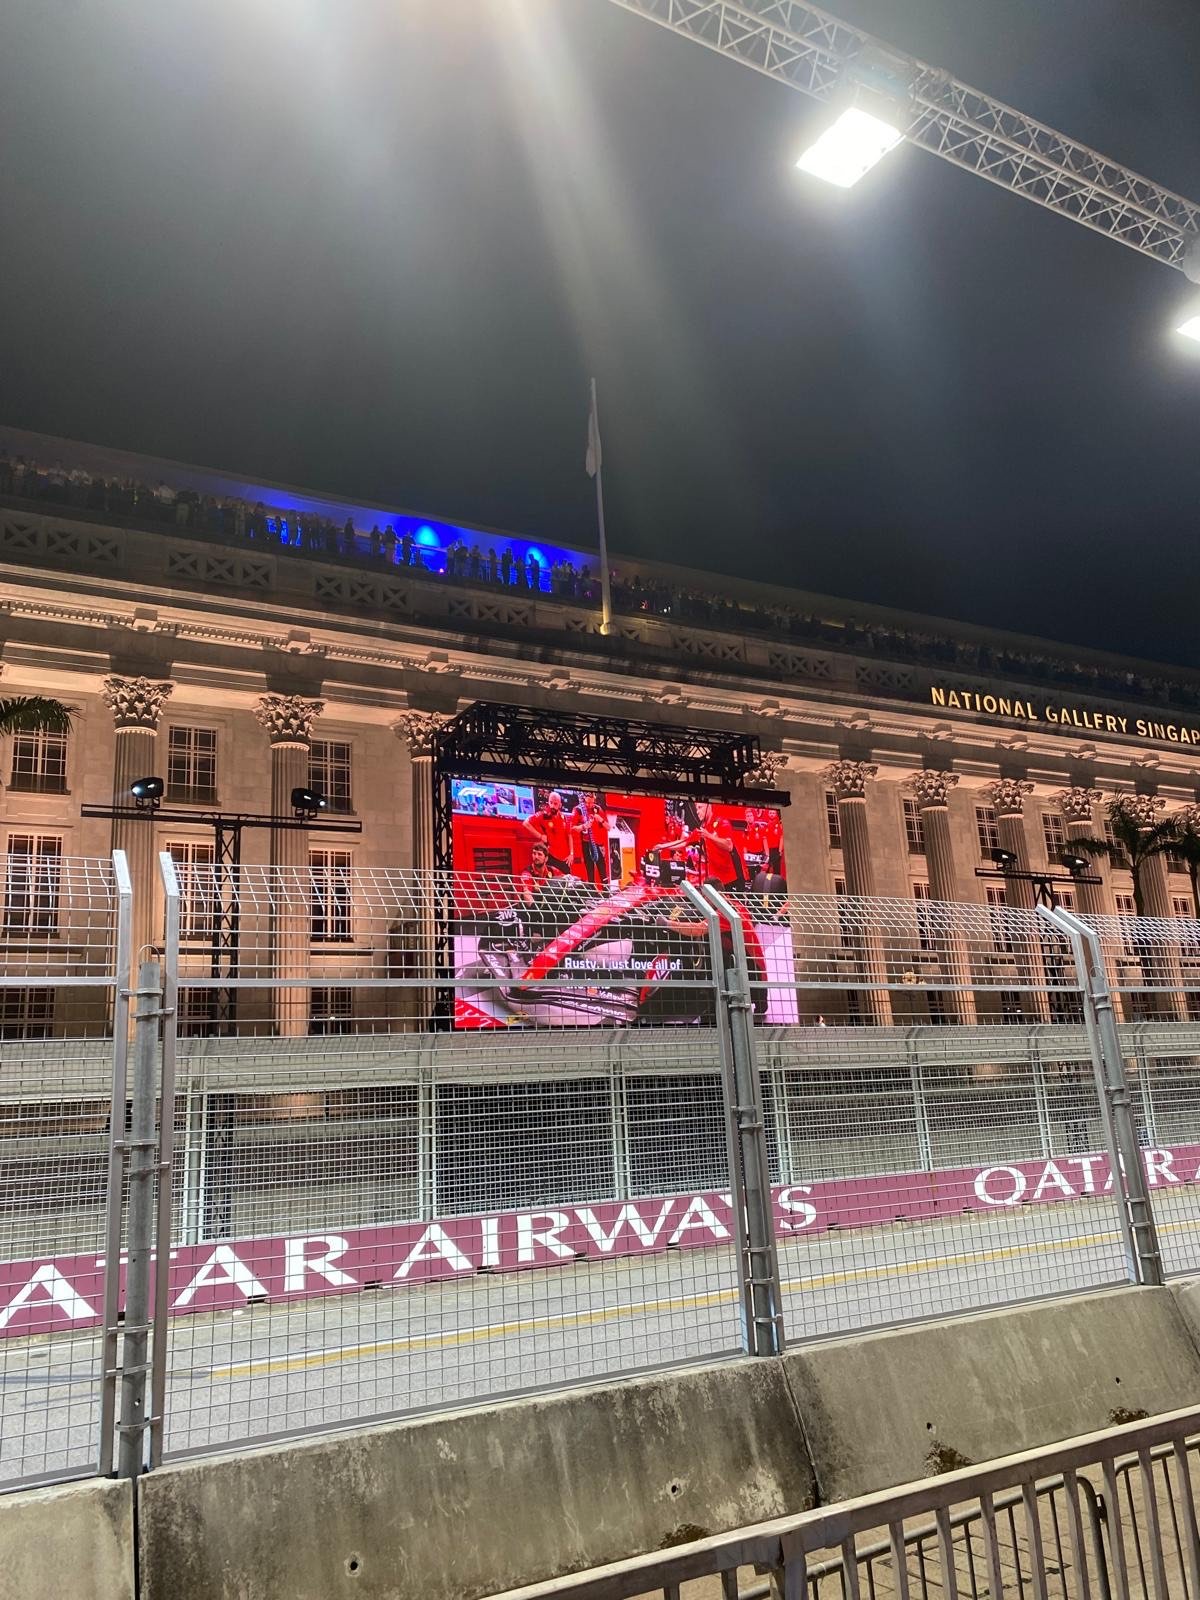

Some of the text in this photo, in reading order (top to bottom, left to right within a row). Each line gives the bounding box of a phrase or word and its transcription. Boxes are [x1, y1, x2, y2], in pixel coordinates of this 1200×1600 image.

[931, 686, 1037, 720] NATIONAL
[1045, 705, 1128, 733] GALLERY
[645, 864, 660, 878] 55
[632, 958, 653, 969] love
[655, 958, 668, 969] all
[670, 958, 680, 969] of
